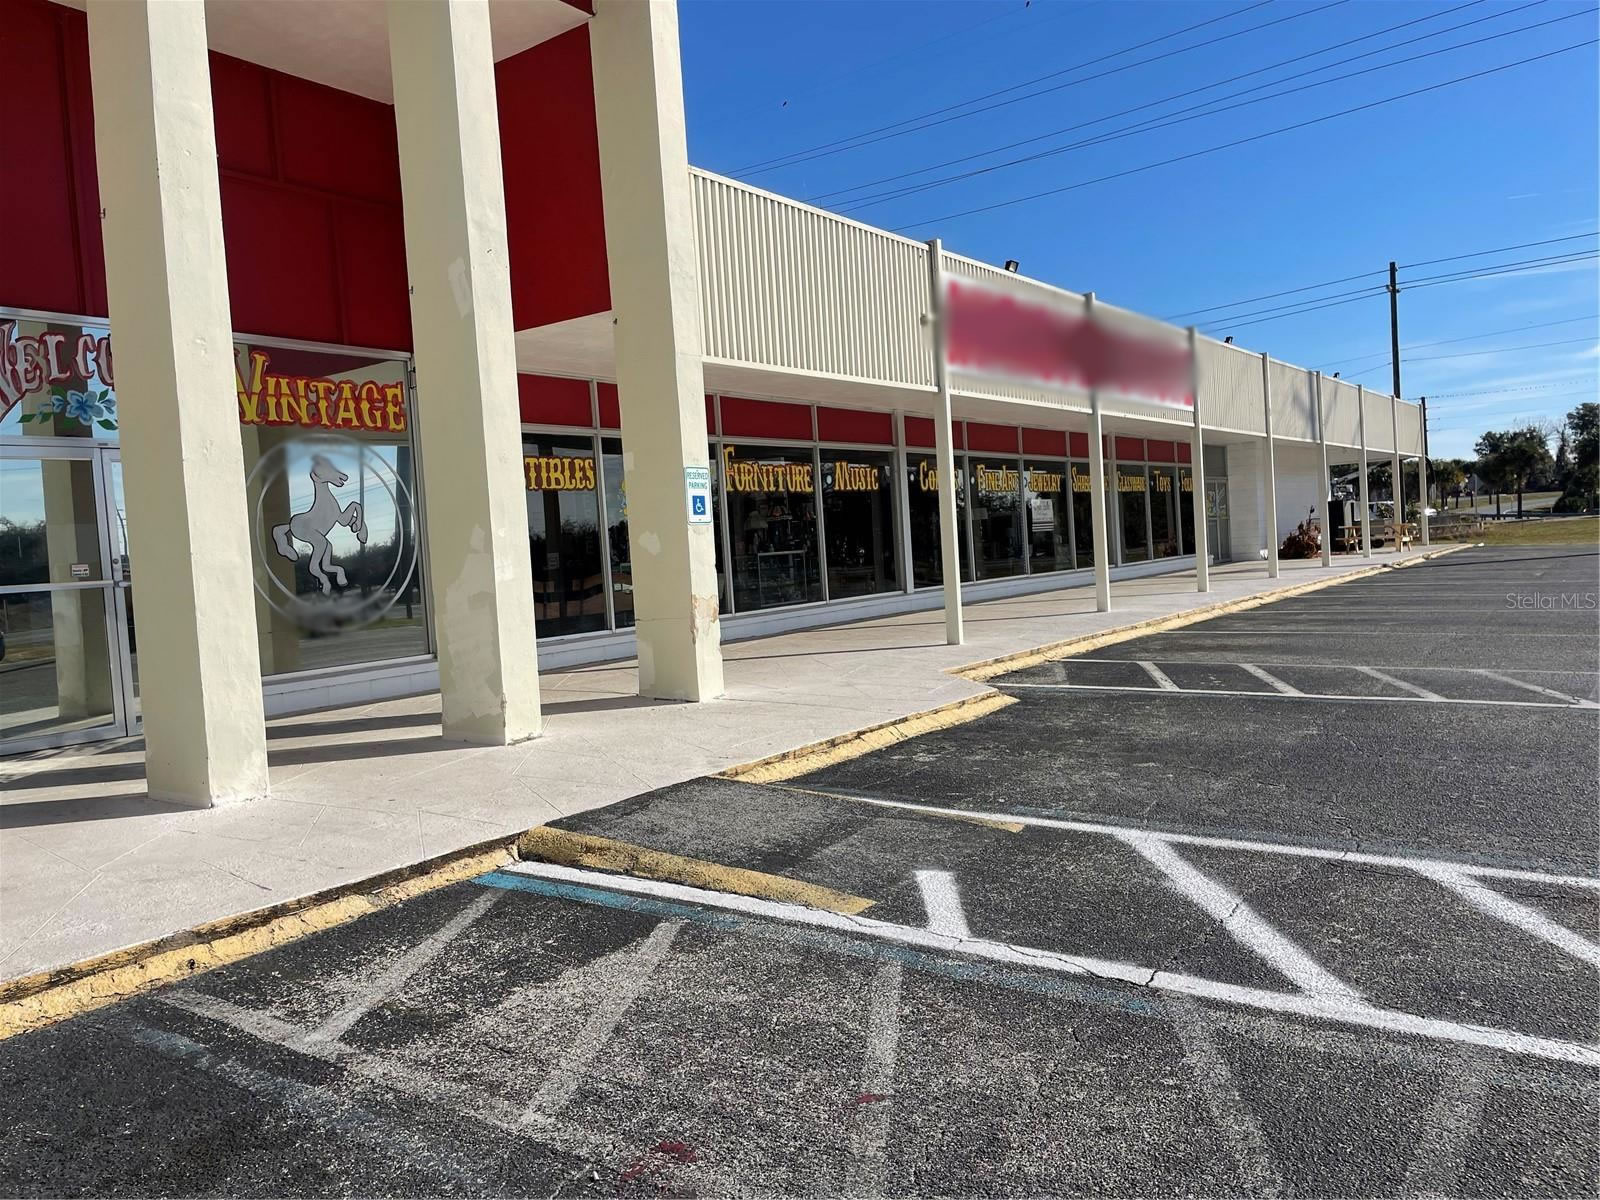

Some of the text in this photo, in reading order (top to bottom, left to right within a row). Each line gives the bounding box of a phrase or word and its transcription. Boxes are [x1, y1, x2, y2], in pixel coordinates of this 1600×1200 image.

[234, 350, 407, 432] VINTAGE
[523, 456, 597, 491] TIBLES
[687, 472, 709, 480] RESERVED
[723, 446, 814, 493] FURNITURE
[833, 460, 879, 491] MUSIC
[1029, 466, 1061, 493] JEWELRY
[1153, 470, 1171, 492] TOYS
[688, 481, 708, 490] PARKING
